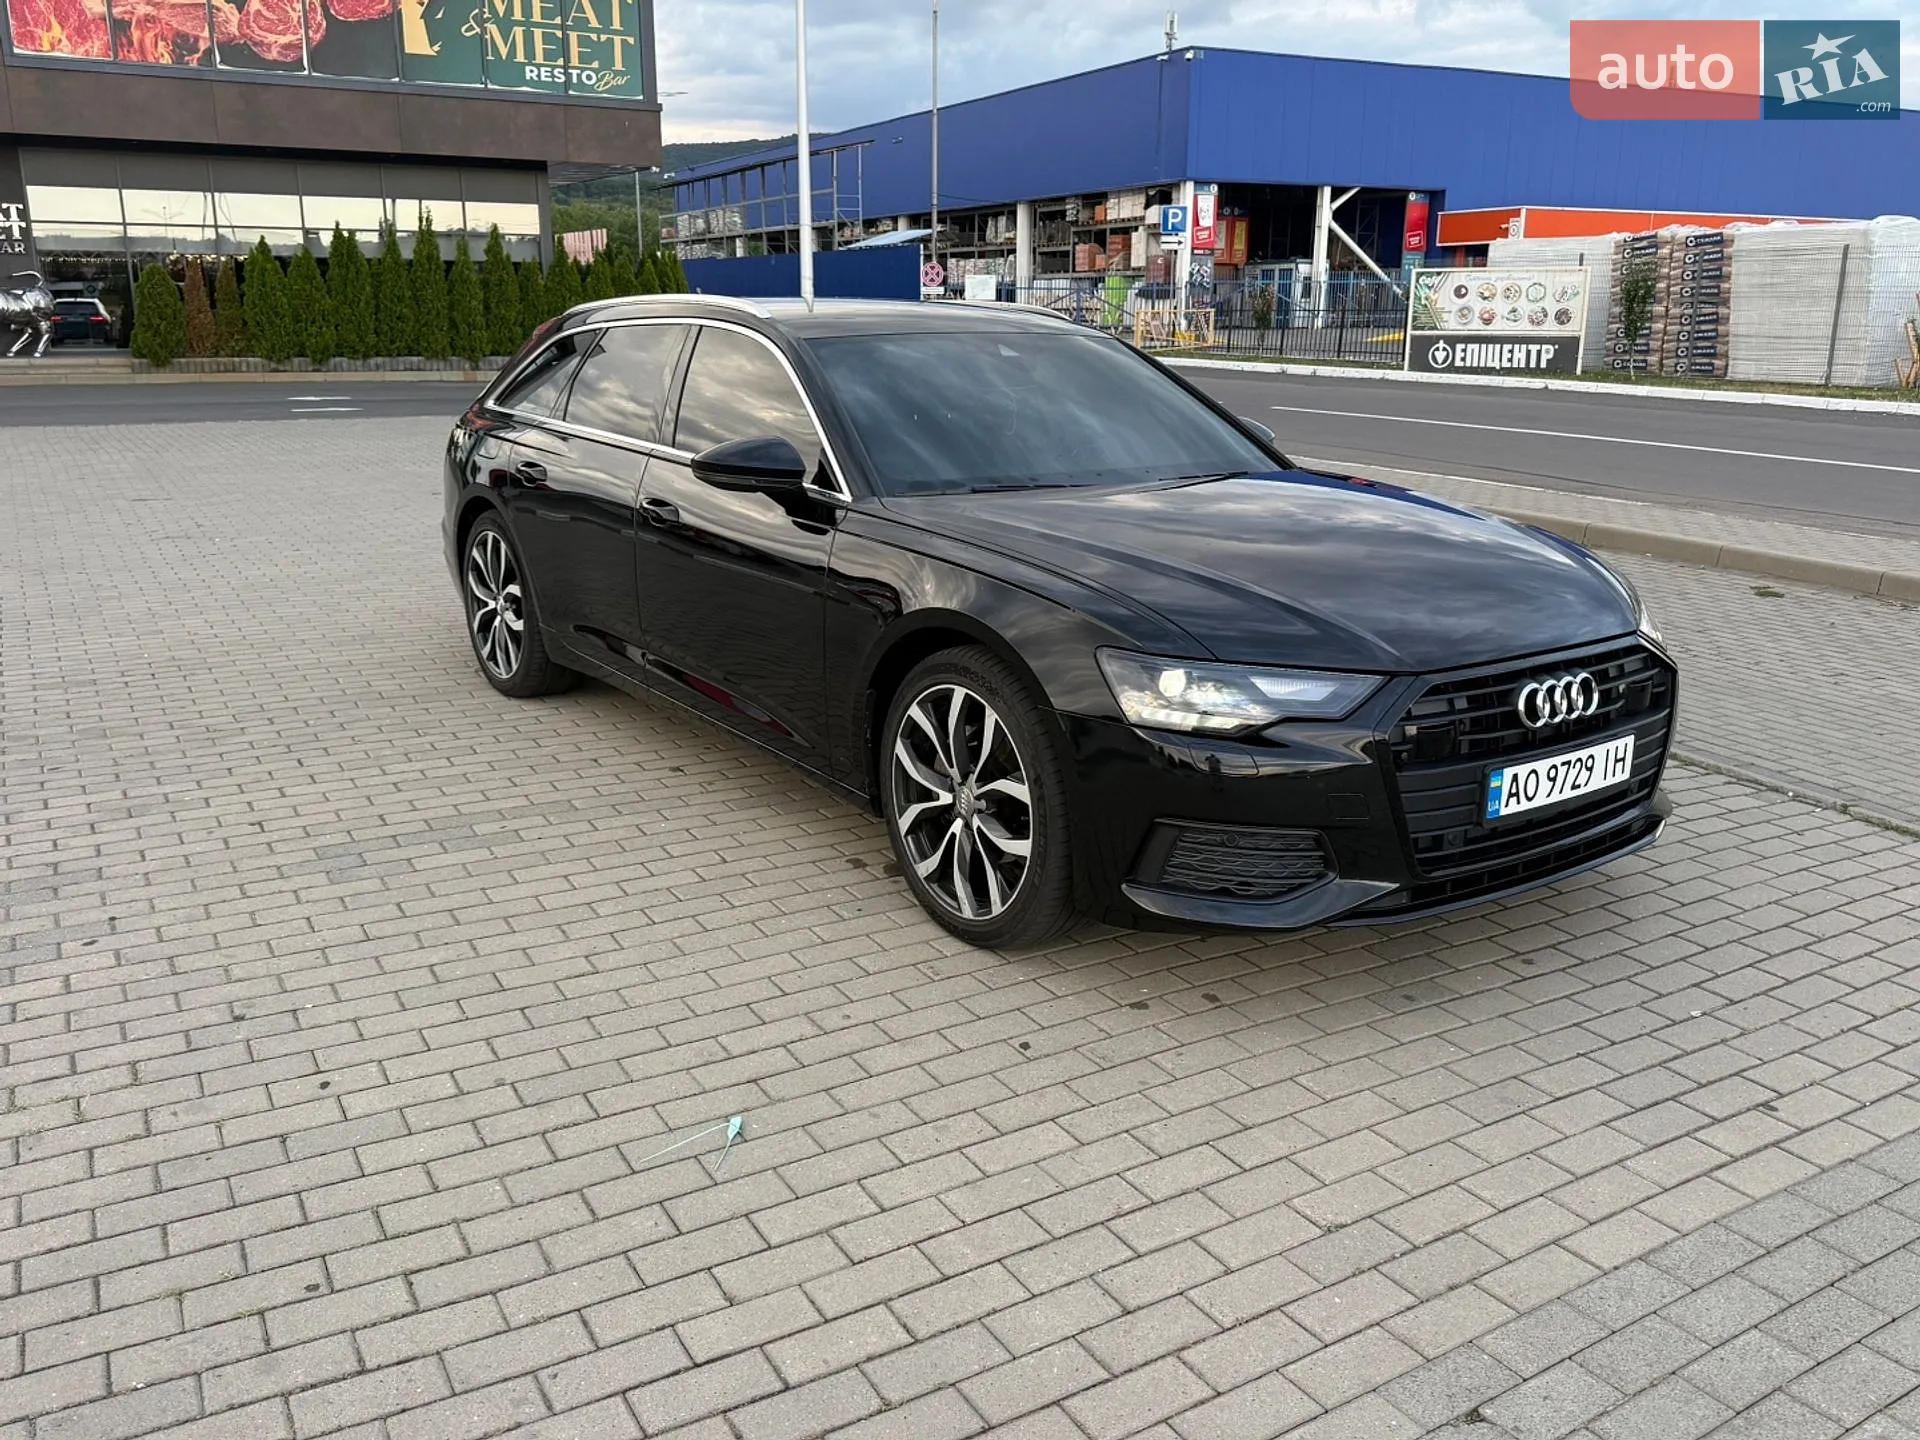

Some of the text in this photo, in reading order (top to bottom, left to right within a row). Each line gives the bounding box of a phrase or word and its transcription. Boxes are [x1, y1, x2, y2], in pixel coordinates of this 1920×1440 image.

[484, 24, 635, 71] MEET
[525, 66, 632, 91] RESTO Bar
[1167, 208, 1183, 231] P
[1454, 343, 1555, 369] ЕПІЦЕНТР
[1504, 742, 1628, 808] AO 9729 IH
